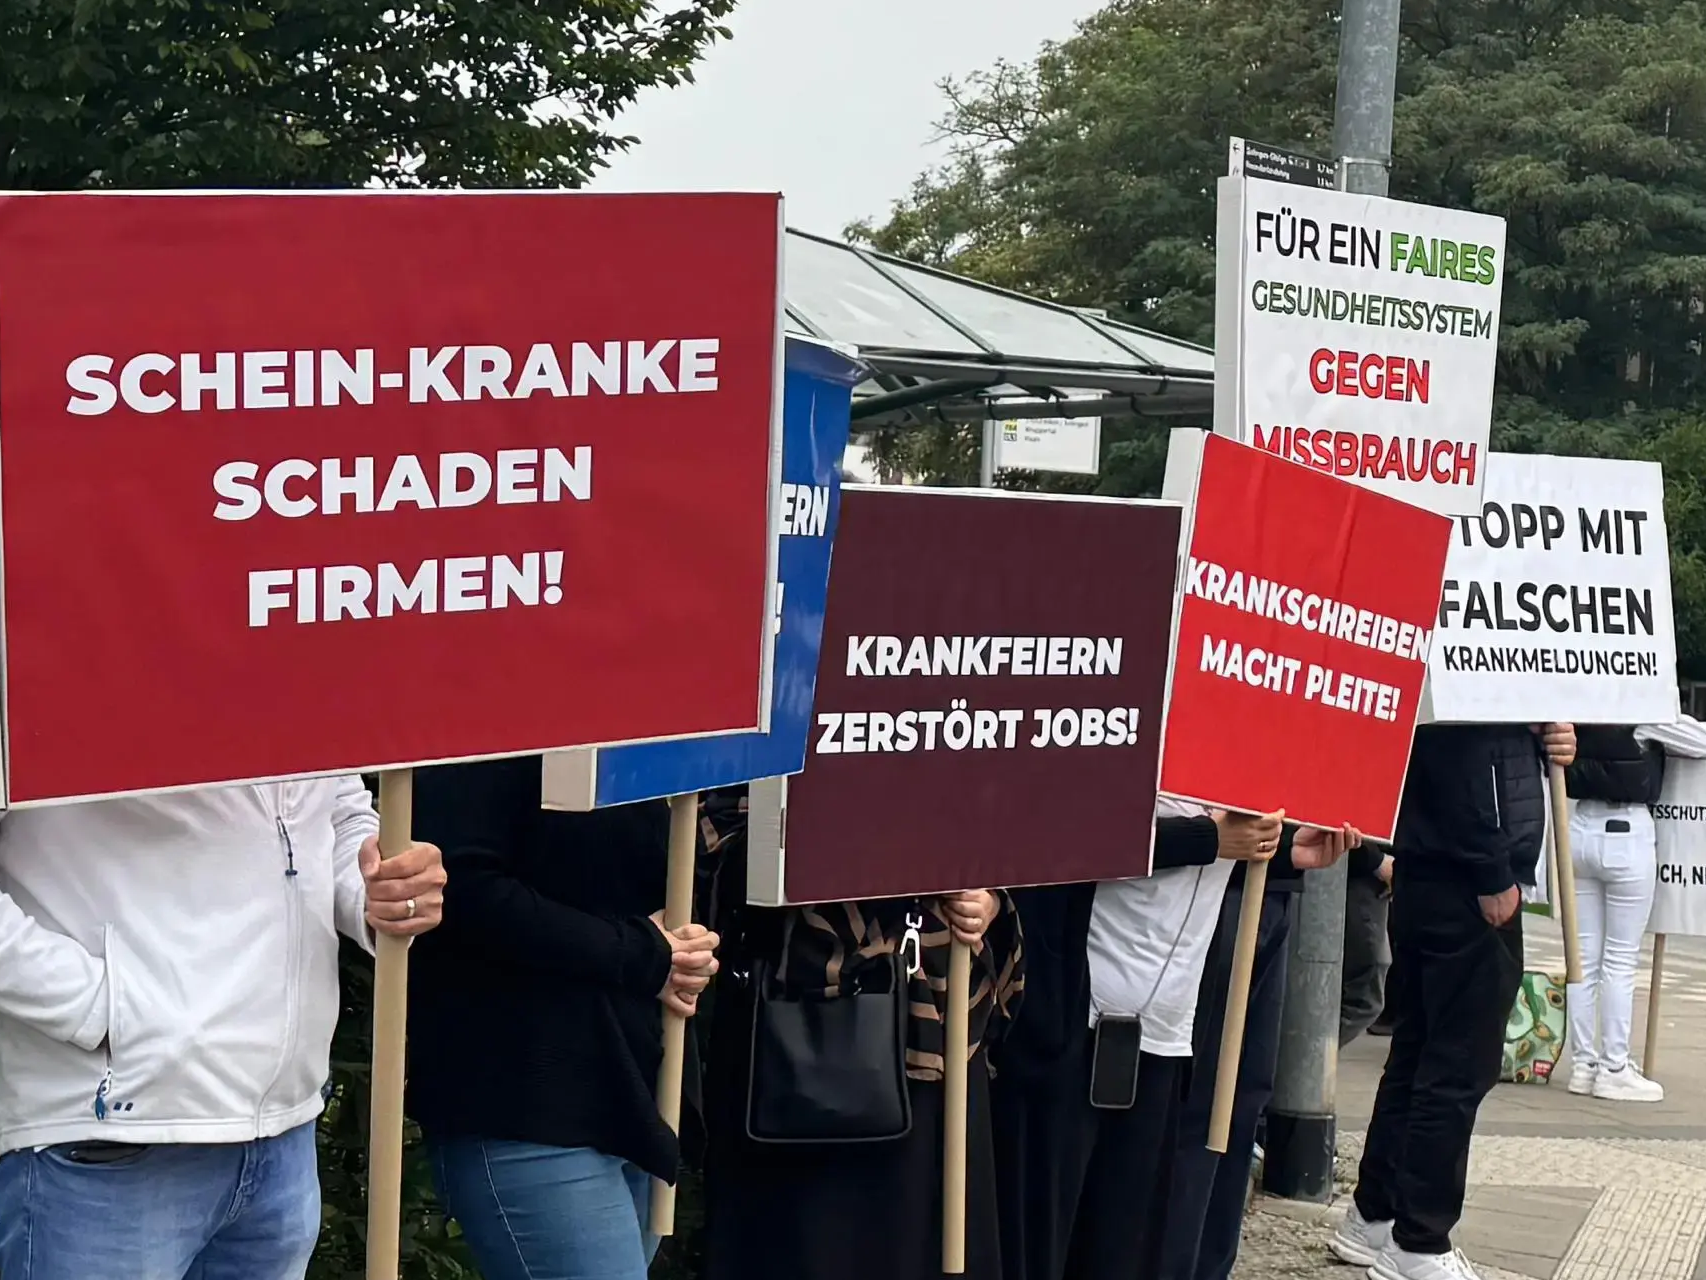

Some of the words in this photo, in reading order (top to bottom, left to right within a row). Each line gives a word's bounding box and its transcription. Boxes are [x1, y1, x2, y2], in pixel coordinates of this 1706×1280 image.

[1256, 206, 1320, 261] FÜR
[1329, 222, 1381, 269] EIN
[1389, 231, 1495, 286] FAIRES
[1251, 280, 1493, 340] GESUNDHEITSSYSTEM
[65, 337, 720, 415] SCHEIN-KRANKE
[1309, 348, 1430, 404] GEGEN
[212, 445, 592, 520] SCHADEN
[1253, 424, 1477, 485] MISSBRAUCH
[778, 483, 830, 537] ERN
[1460, 501, 1565, 550] TOPP
[1578, 507, 1647, 555] MIT
[248, 551, 564, 627] FIRMEN!
[1185, 556, 1434, 664] KRANKSCHREIBEN
[1439, 580, 1654, 636] FALSCHEN
[846, 636, 1122, 676] KRANKFEIERN
[1200, 634, 1301, 695] MACHT
[1304, 664, 1401, 722] PLEITE!
[1443, 645, 1657, 676] KRANKMELDUNGEN!
[816, 698, 1024, 754] ZERSTÖRT
[1030, 708, 1140, 749] JOBS!
[1656, 863, 1687, 888] CH,
